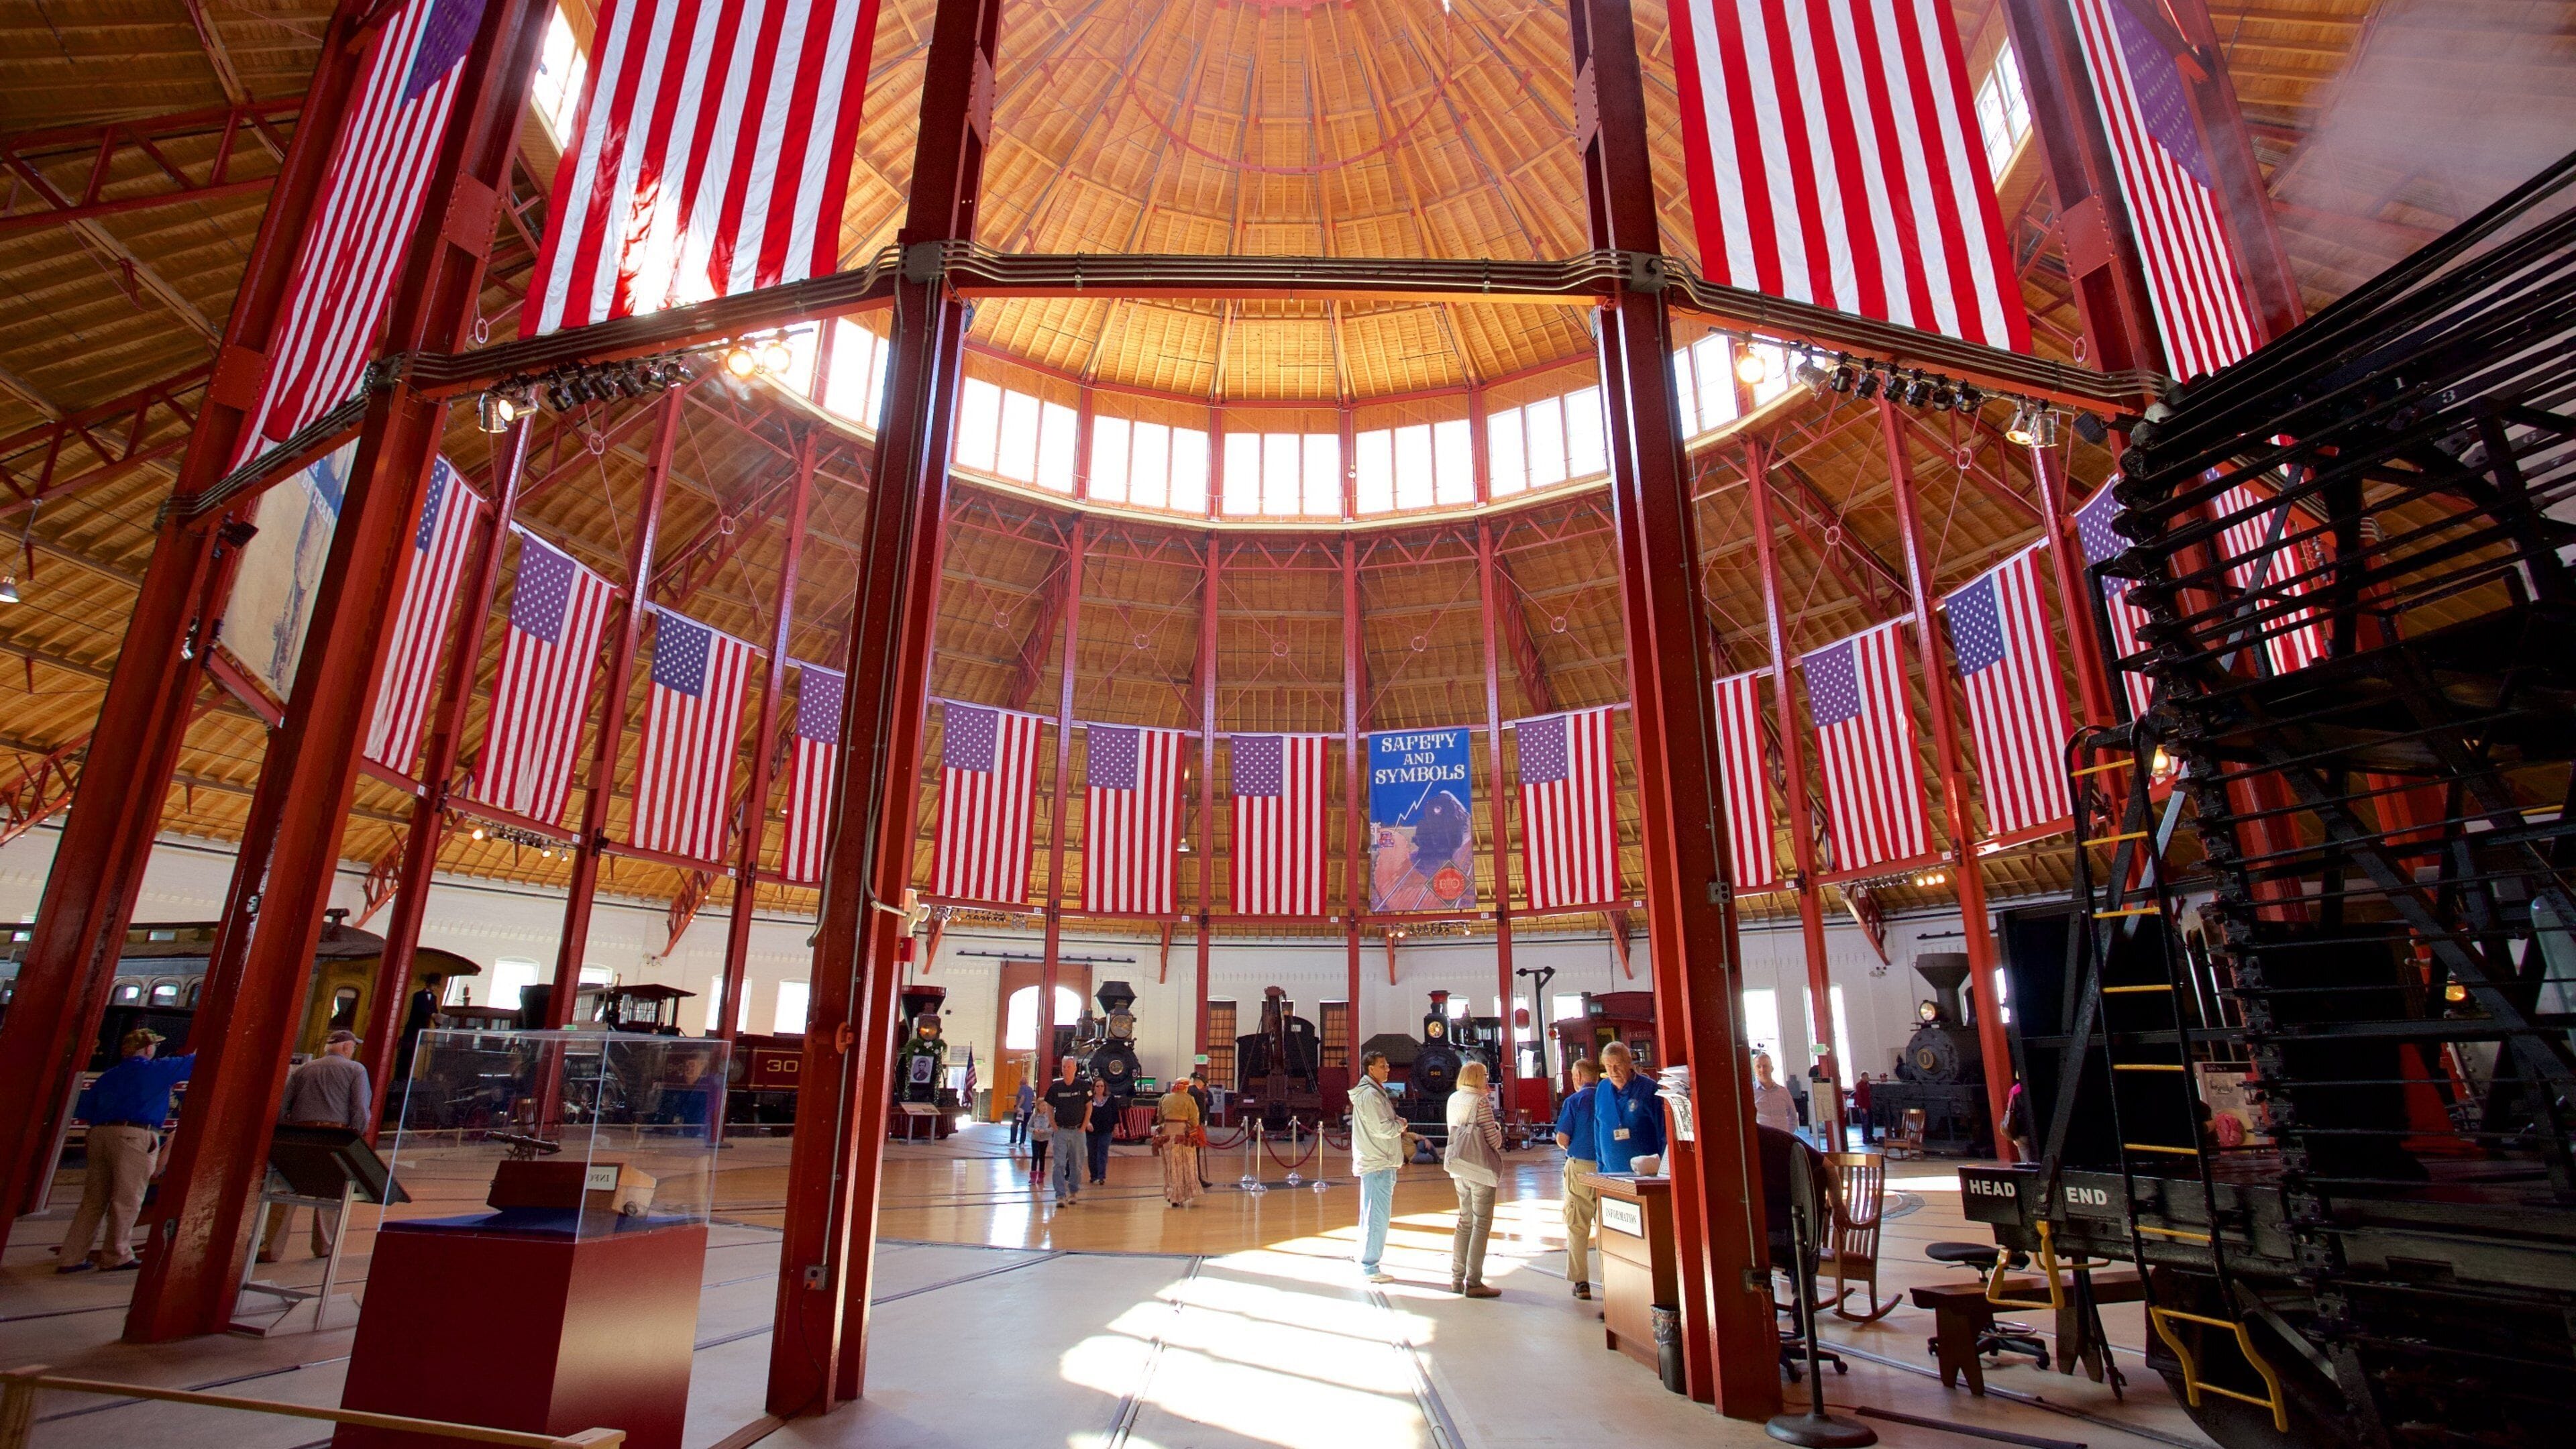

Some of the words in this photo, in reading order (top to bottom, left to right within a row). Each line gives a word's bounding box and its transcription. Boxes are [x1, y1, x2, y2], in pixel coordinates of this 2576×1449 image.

[2443, 390, 2455, 402] 3
[1381, 733, 1457, 753] SAFETY
[1403, 752, 1435, 765] AND
[1376, 764, 1465, 784] SYMBOLS
[1969, 1179, 2015, 1197] HEAD
[2066, 1187, 2107, 1205] END
[1605, 1207, 1637, 1224] INFORMATION
